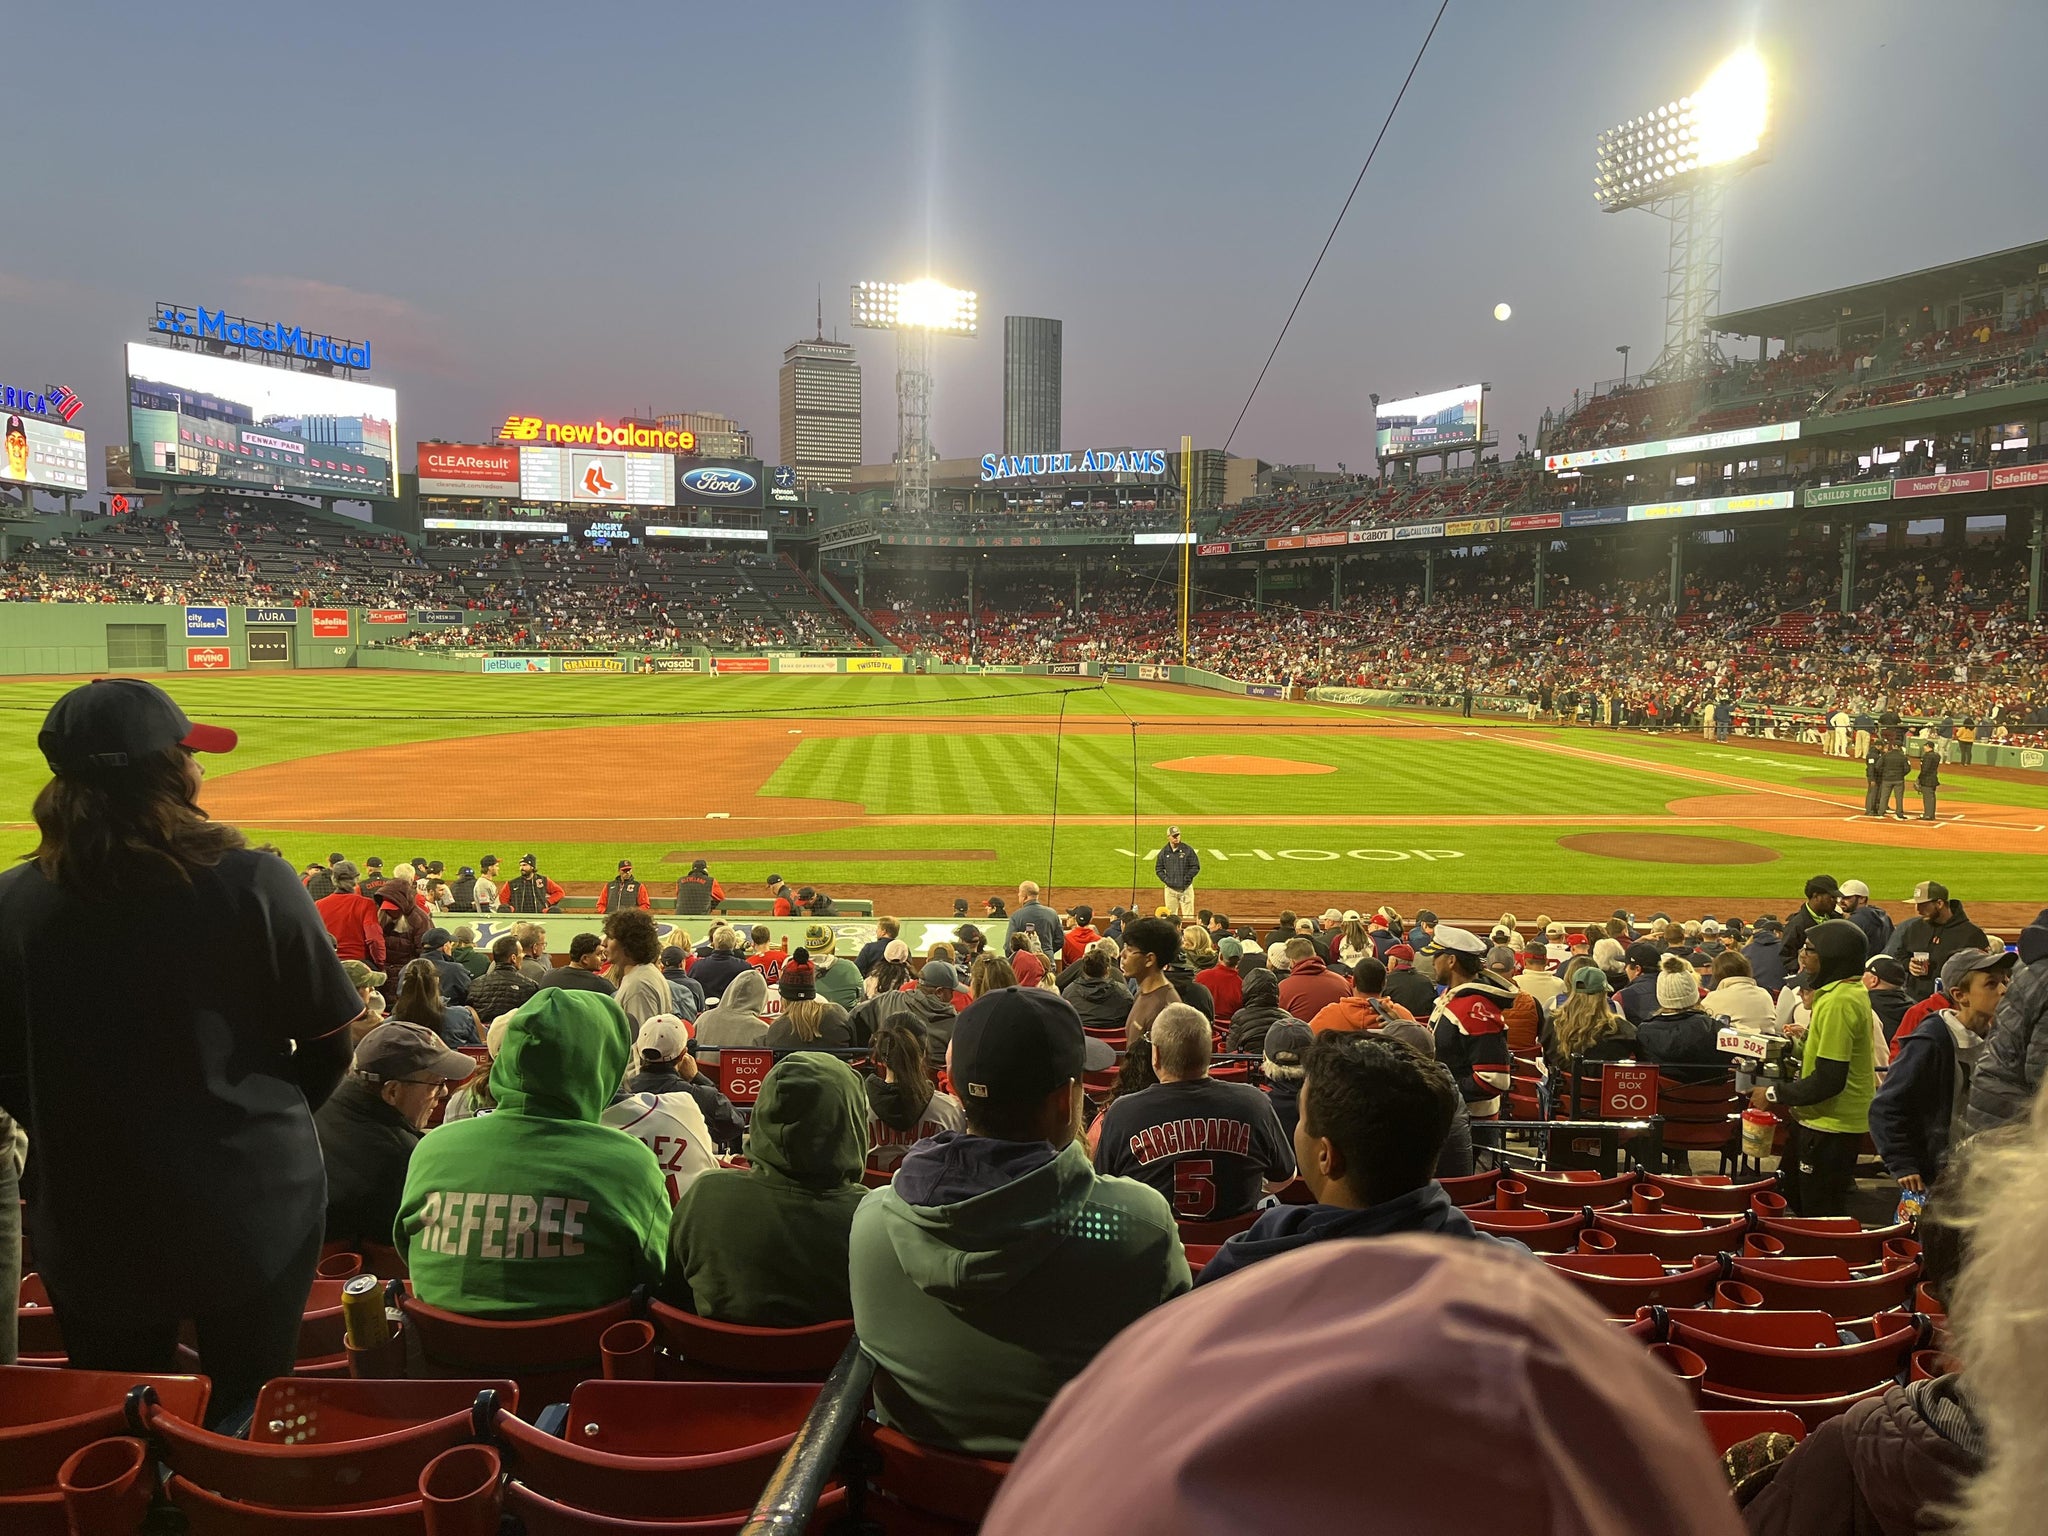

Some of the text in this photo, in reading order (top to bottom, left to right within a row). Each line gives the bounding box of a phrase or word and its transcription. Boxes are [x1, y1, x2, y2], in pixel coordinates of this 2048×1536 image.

[197, 306, 371, 369] MassMutual
[546, 423, 594, 444] new
[596, 420, 695, 449] balance
[246, 434, 301, 451] FENWAY PARK
[428, 455, 509, 469] CLEAResult
[981, 448, 1165, 481] SAMUEL ADAMS
[697, 471, 741, 492] Ford
[1913, 481, 1937, 491] Ninety
[1952, 479, 1970, 488] Nine
[1995, 472, 2038, 485] Safelite
[771, 487, 794, 495] Johnson
[1817, 486, 1887, 501] GRILLO'S PICKLES
[591, 522, 623, 531] ANGRY
[584, 529, 630, 538] ORCHARD
[1213, 545, 1225, 553] PIZZA
[188, 613, 203, 622] city
[384, 613, 407, 622] TICKET
[193, 654, 224, 662] IRVING
[563, 658, 624, 671] GRANITE CITY
[658, 659, 694, 668] wasabi
[487, 660, 521, 671] jetBlue
[857, 661, 892, 670] TWISTED TEA
[1720, 1037, 1764, 1055] RED SOX
[731, 1057, 762, 1065] FIELD
[736, 1066, 758, 1074] BOX
[1614, 1072, 1646, 1080] FIELD
[730, 1079, 762, 1095] 62
[1611, 1094, 1647, 1110] 60
[1130, 1118, 1250, 1166] GARCIAPARRA
[1173, 1159, 1215, 1217] 5
[420, 1191, 590, 1260] REFEREE
